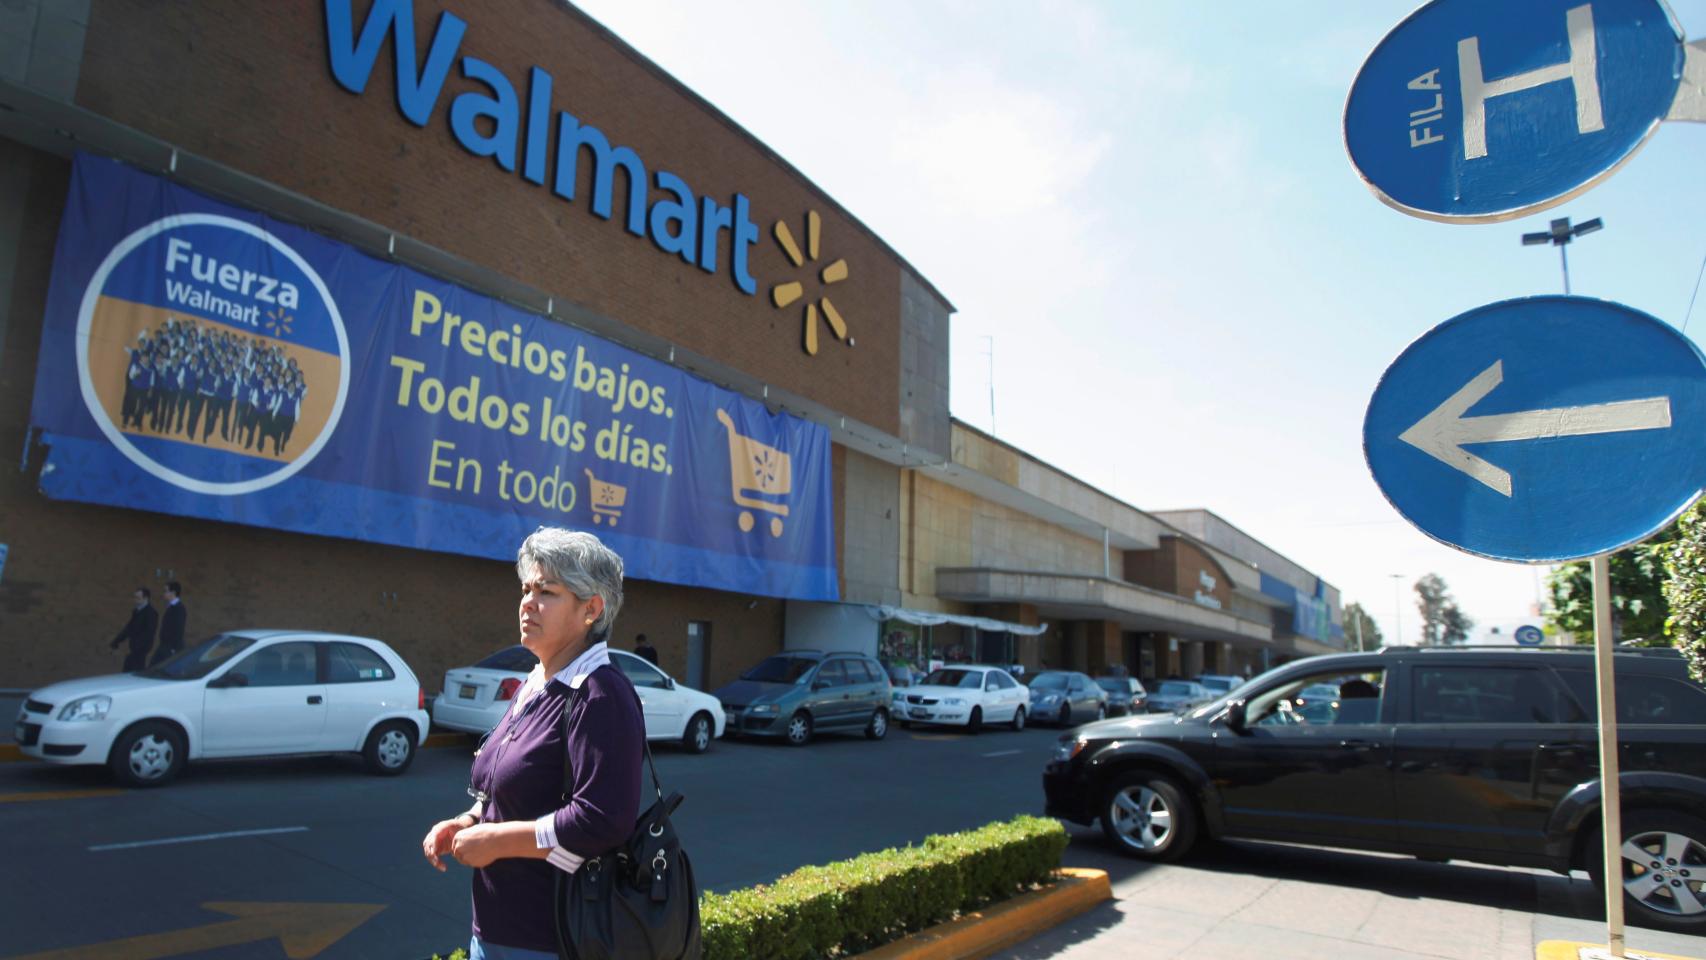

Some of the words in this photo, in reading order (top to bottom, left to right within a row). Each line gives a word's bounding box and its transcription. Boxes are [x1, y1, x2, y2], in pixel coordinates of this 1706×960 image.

[1407, 68, 1444, 148] FILA
[1457, 3, 1605, 160] H
[324, 0, 759, 296] Walmart
[165, 237, 299, 309] Fuerza
[165, 279, 261, 326] Walmart
[410, 289, 567, 382] Precios
[573, 346, 674, 419] bajos.
[390, 355, 531, 436] Todos
[540, 397, 588, 452] los
[595, 420, 673, 475] días.
[428, 440, 483, 494] En
[498, 460, 576, 513] todo
